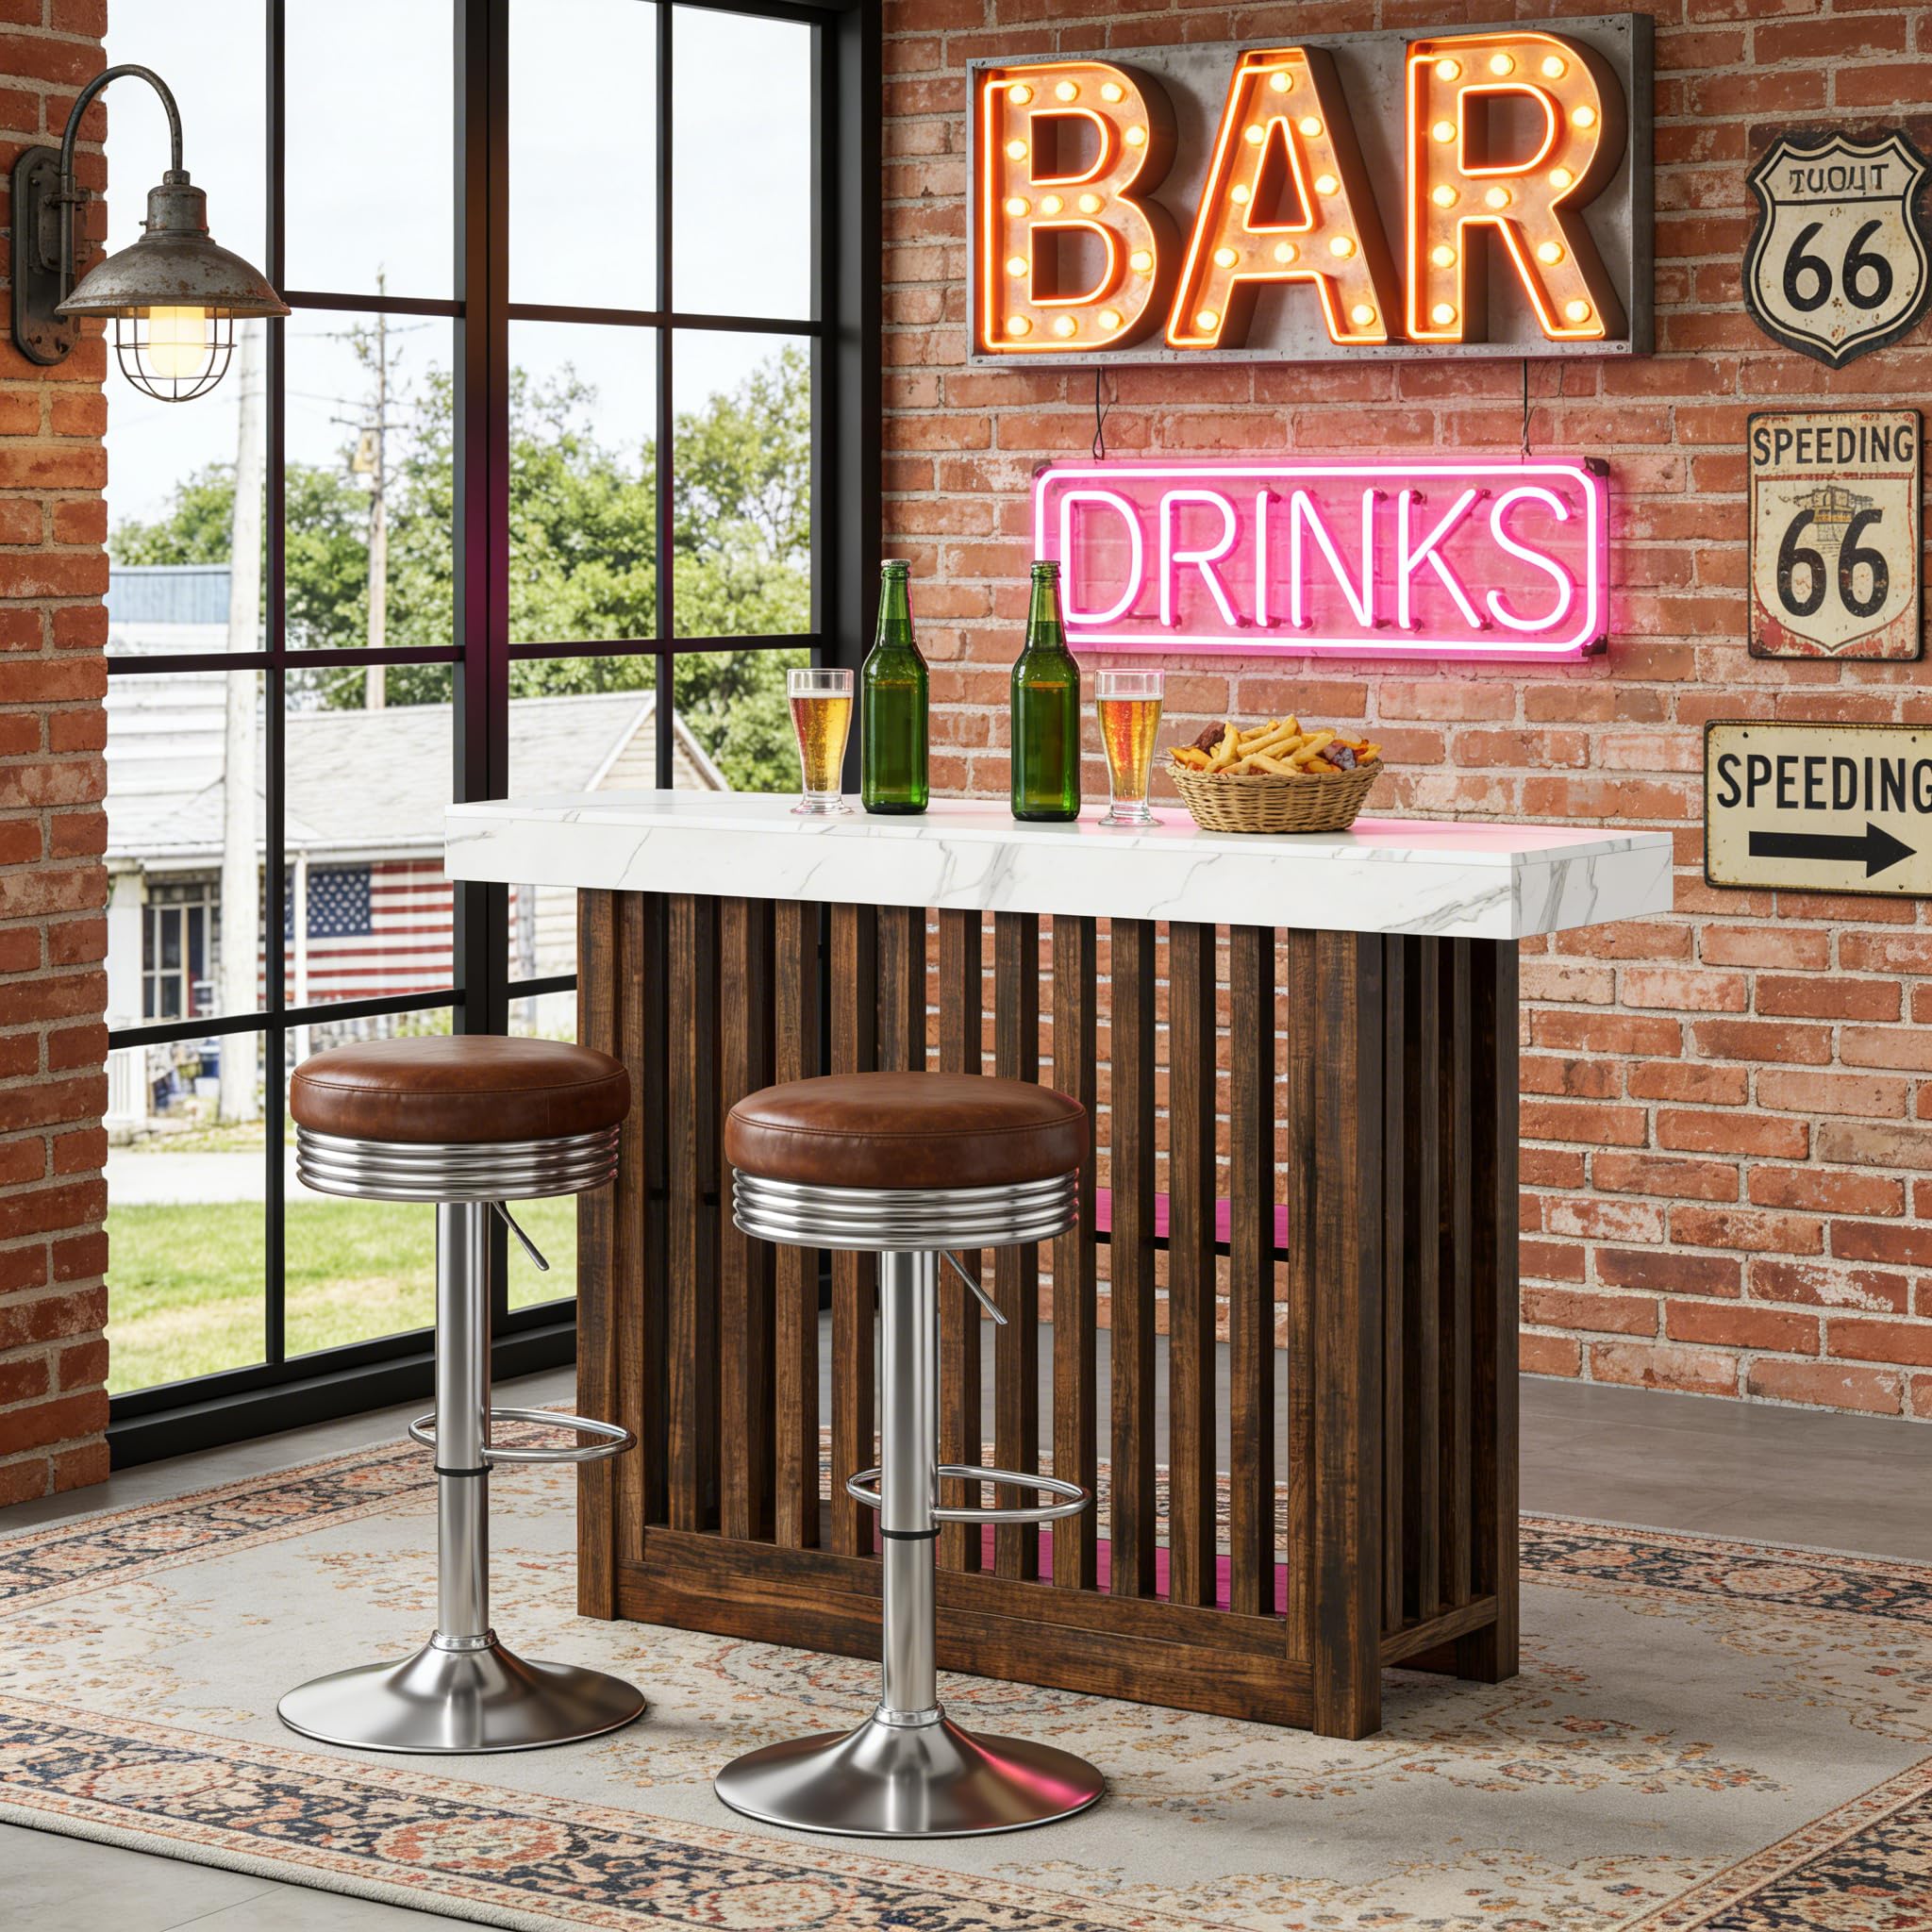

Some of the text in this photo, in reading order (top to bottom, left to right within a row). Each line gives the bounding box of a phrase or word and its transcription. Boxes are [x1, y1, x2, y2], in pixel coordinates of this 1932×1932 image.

[977, 31, 1619, 352] BAR
[1783, 219, 1893, 312] 66
[1753, 425, 1914, 466] SPEEDING
[1059, 486, 1575, 631] DRINKS
[1776, 508, 1890, 618] 66
[1716, 753, 1932, 814] SPEEDING
